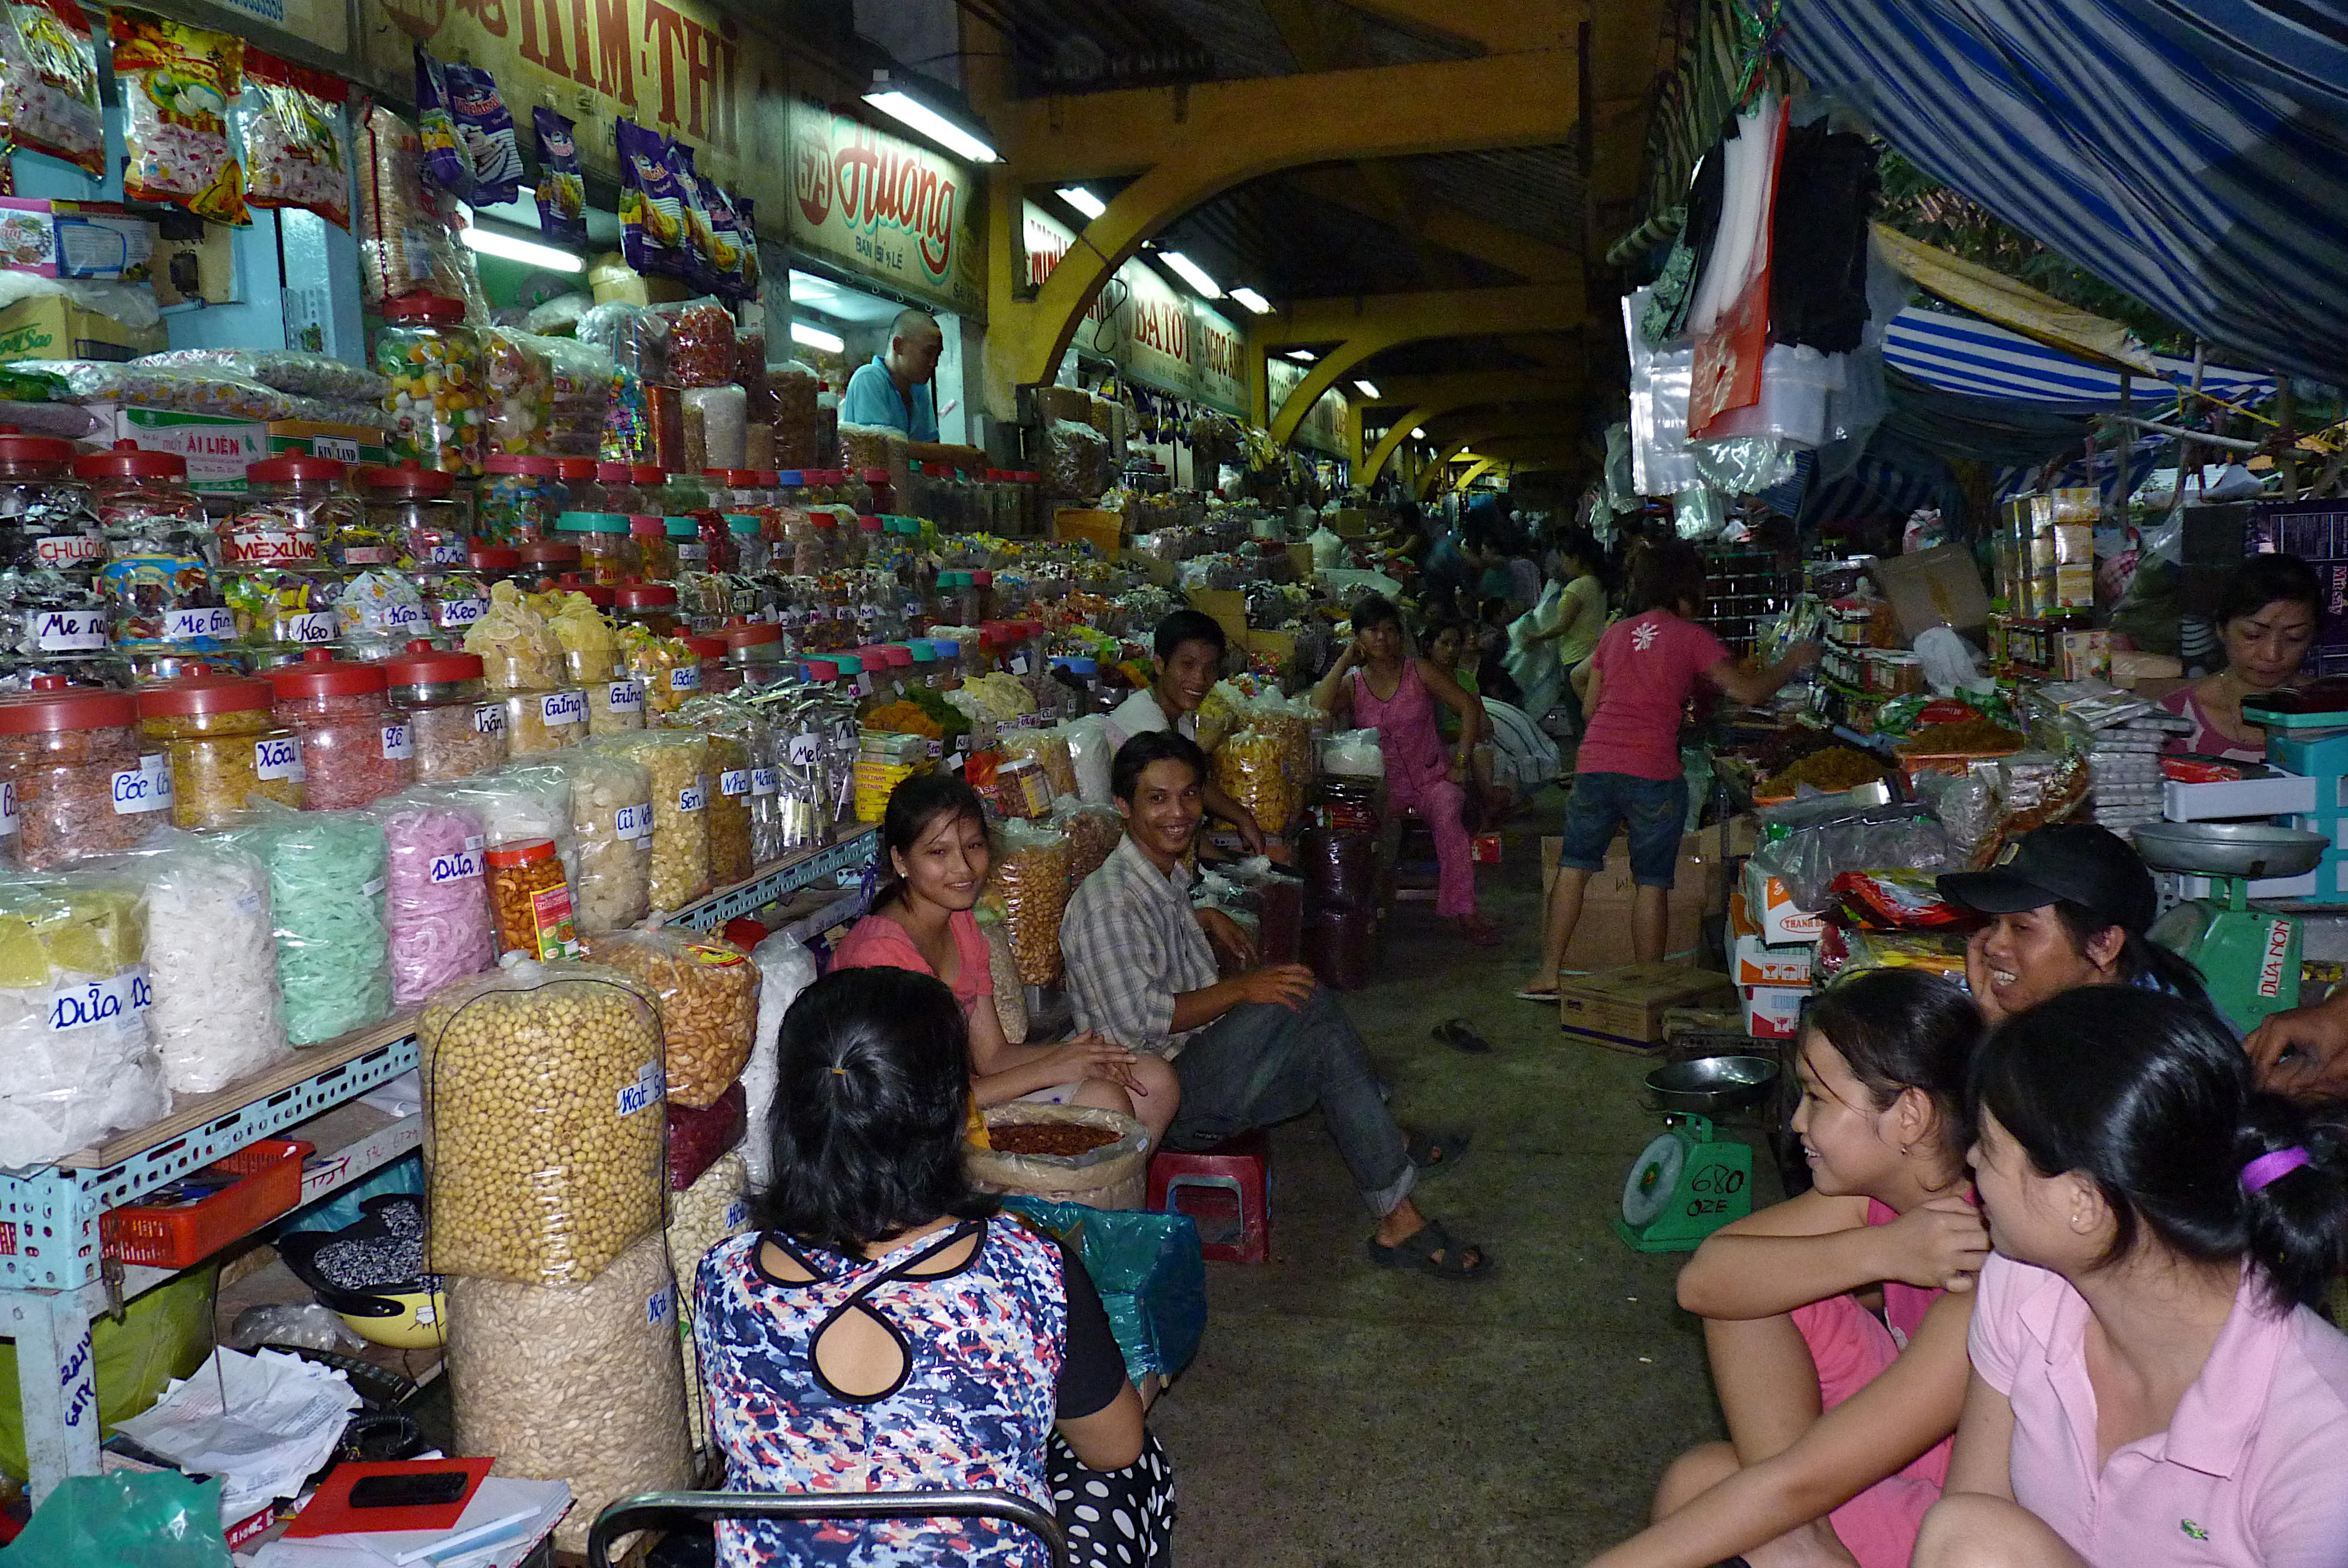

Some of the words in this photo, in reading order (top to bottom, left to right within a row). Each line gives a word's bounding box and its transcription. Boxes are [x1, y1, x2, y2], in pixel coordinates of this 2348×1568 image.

[798, 143, 829, 209] 679
[42, 614, 80, 637] Me
[173, 614, 205, 634] Me
[114, 769, 149, 801] Cóc
[723, 772, 746, 793] Nho
[681, 791, 700, 810] Sen
[1785, 918, 1813, 930] THANH
[2269, 920, 2290, 957] NON
[1692, 1164, 1745, 1194] 680
